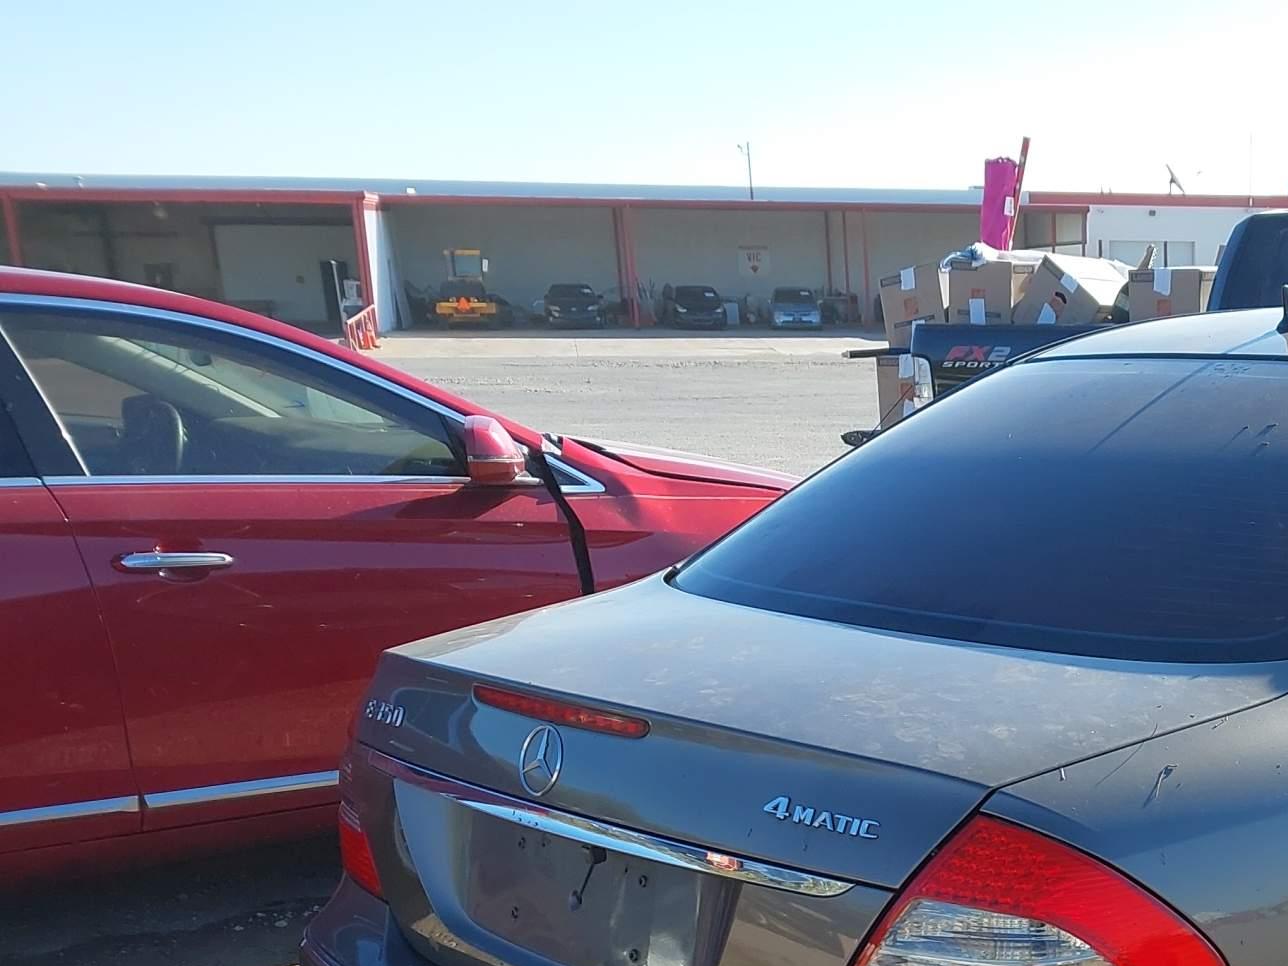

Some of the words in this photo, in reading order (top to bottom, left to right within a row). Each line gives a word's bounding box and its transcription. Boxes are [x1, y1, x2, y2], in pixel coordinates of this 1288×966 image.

[945, 345, 1012, 361] FX2
[942, 361, 1004, 369] SPORT
[763, 796, 880, 839] 4MATIC
